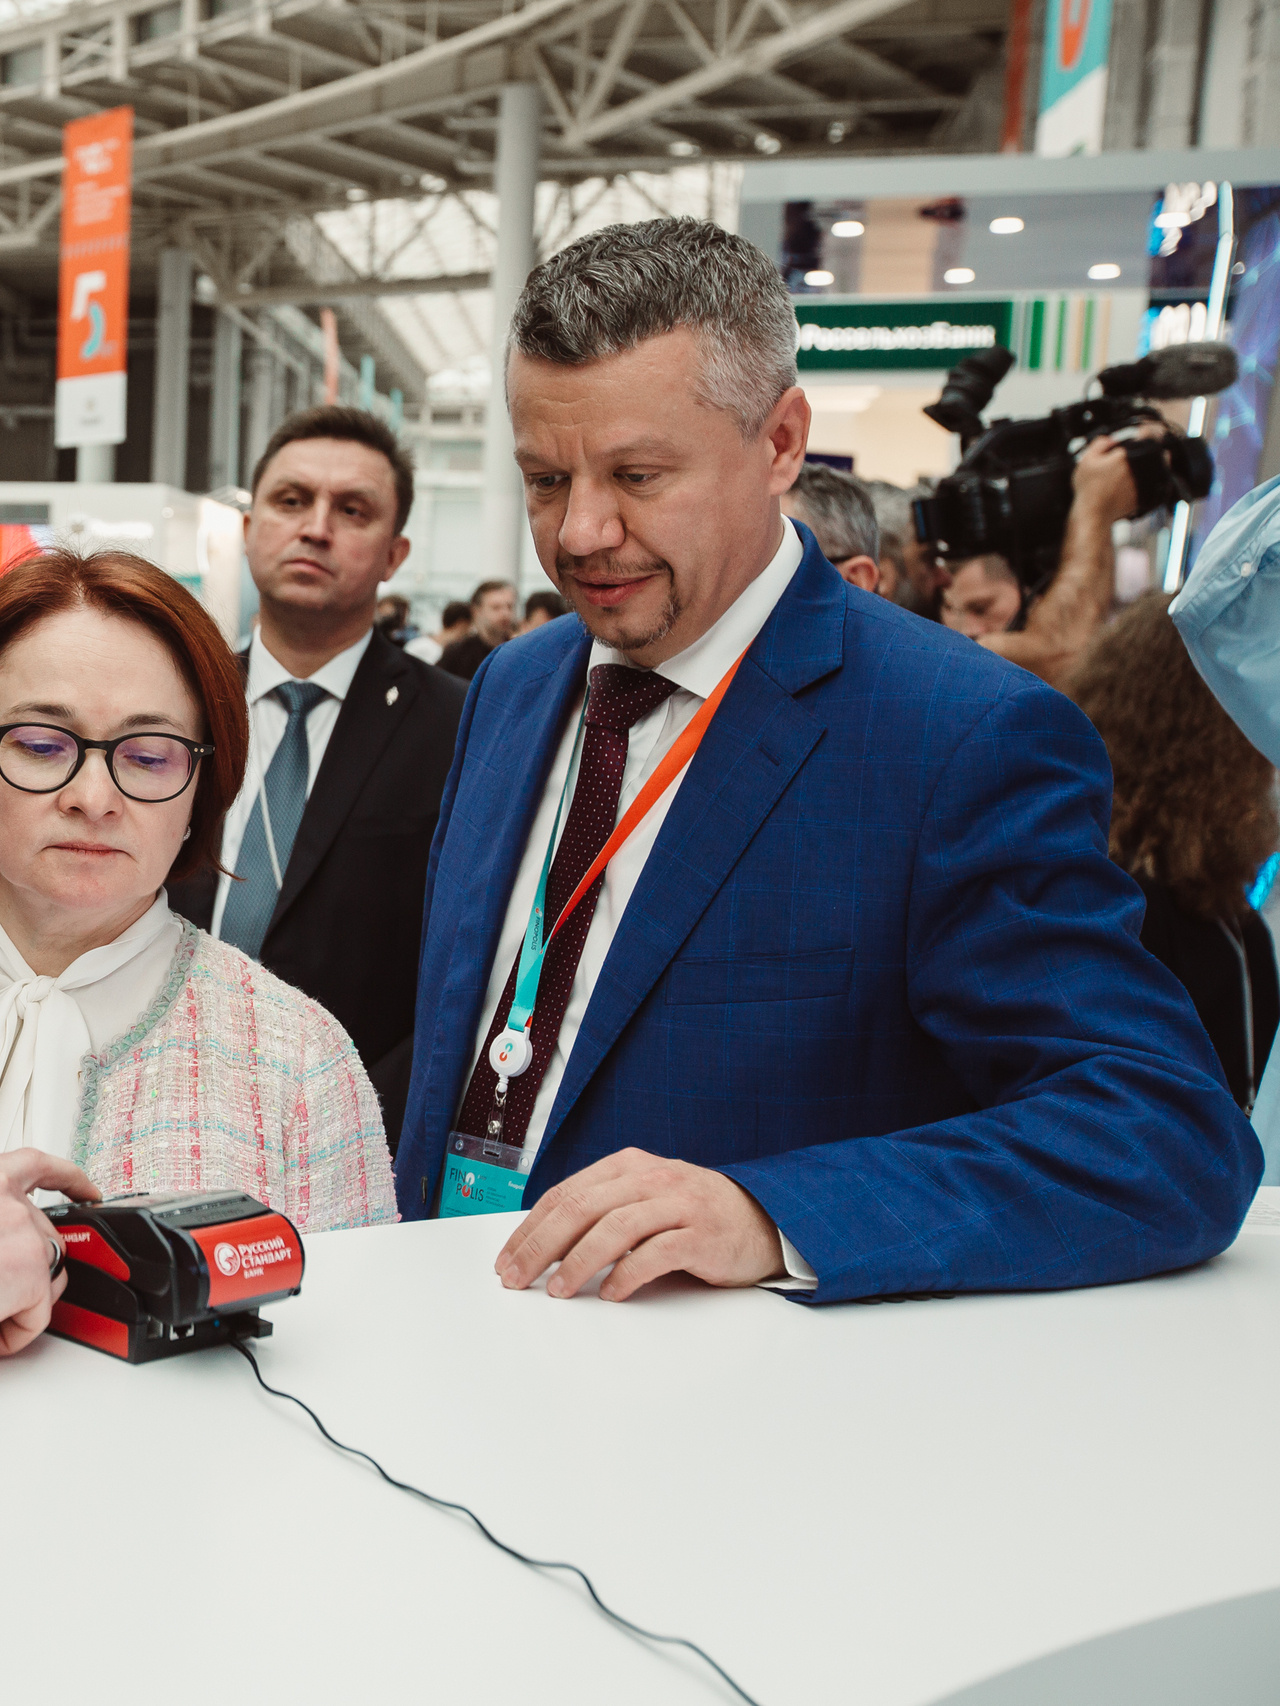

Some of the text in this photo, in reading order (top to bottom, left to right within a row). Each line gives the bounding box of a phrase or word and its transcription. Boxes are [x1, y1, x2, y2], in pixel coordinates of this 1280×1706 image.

[531, 916, 541, 951] FINOPOLIS
[455, 1182, 485, 1202] POLIS
[238, 1235, 285, 1257] РУССКИЙ
[241, 1247, 292, 1269] СТАНДАРТ
[243, 1267, 264, 1279] БАНК
